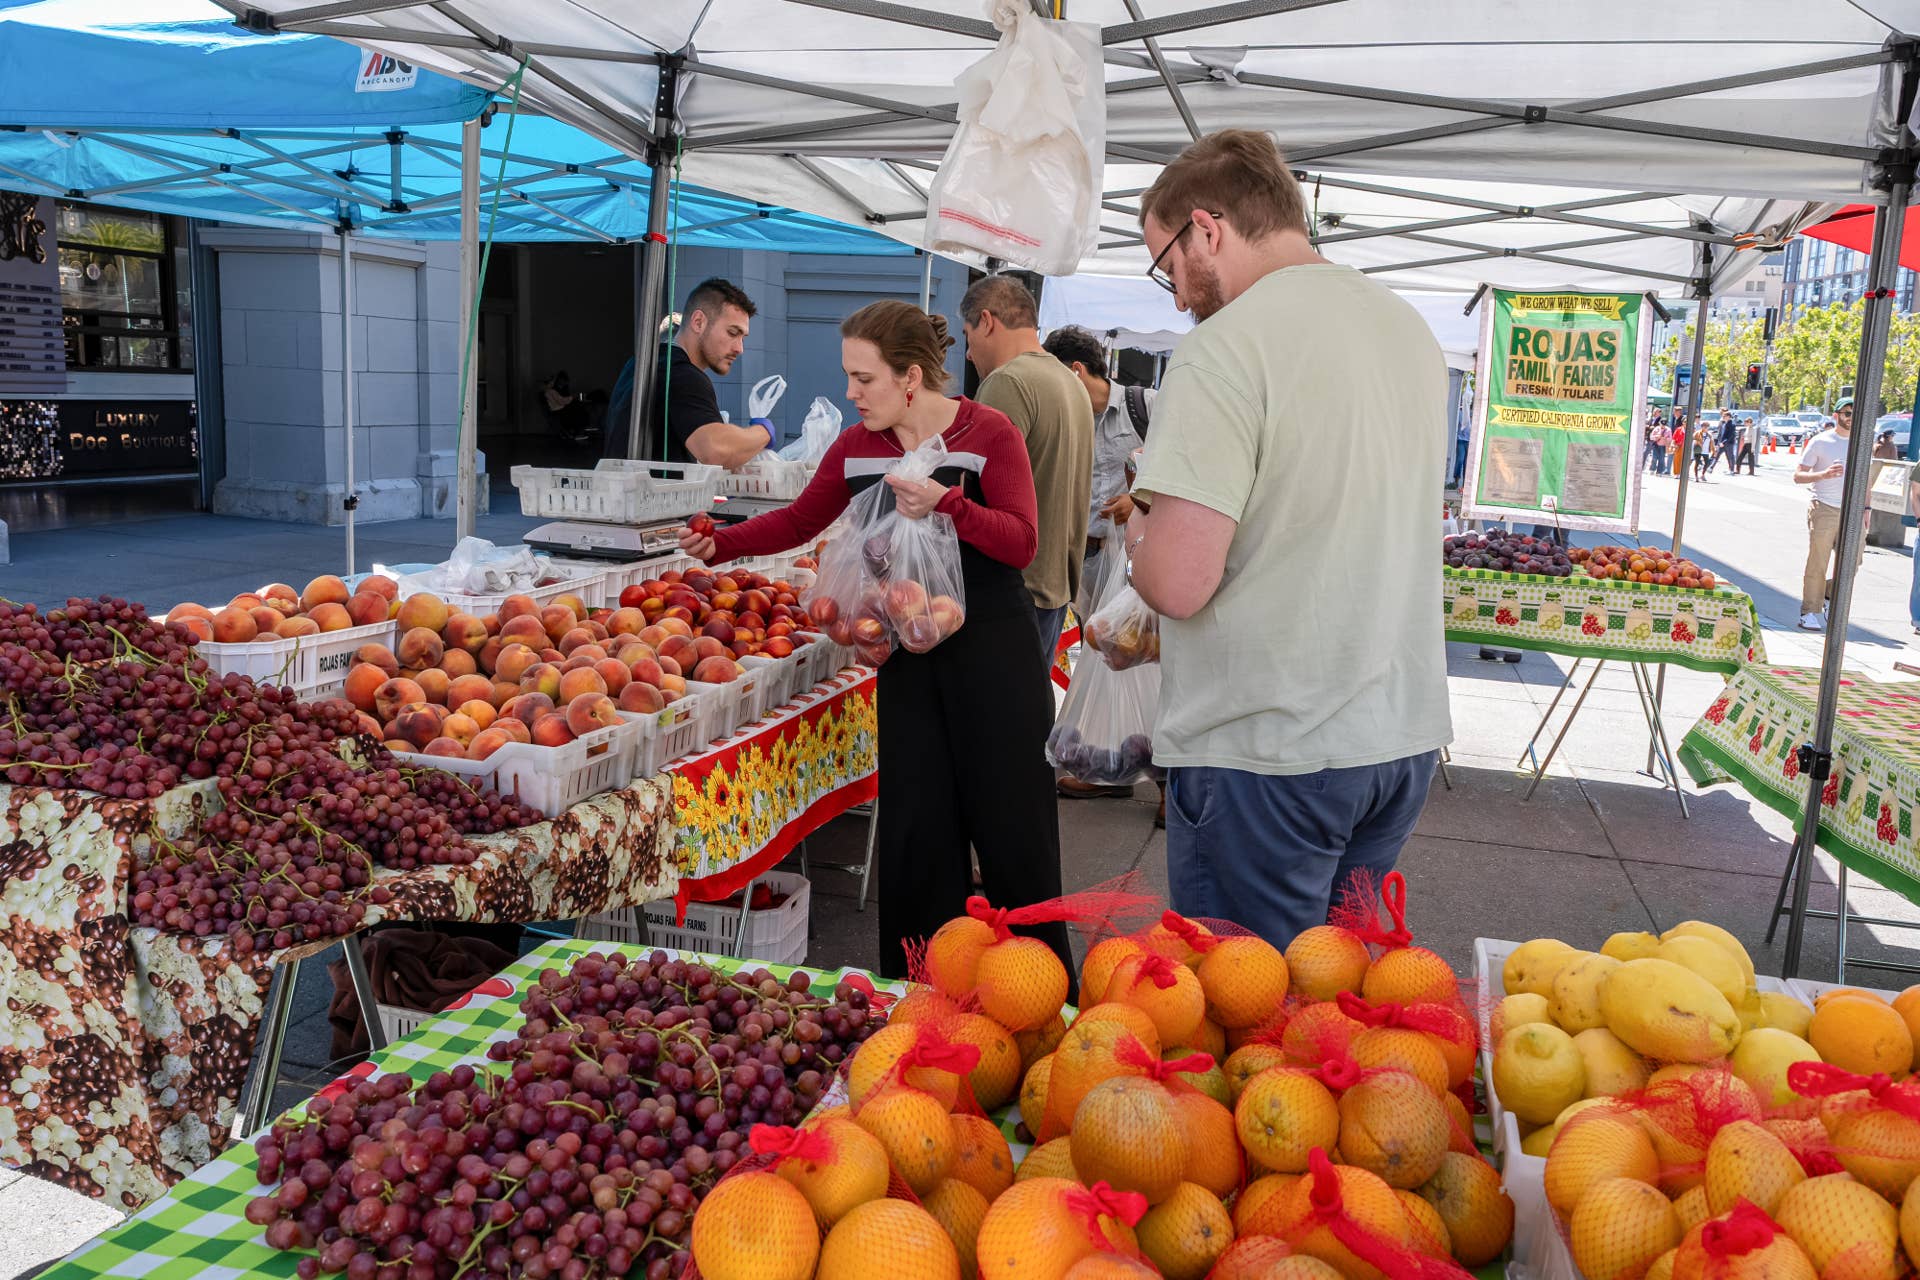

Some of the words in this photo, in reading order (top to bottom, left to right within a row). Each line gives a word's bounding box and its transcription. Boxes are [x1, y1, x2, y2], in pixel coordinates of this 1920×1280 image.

[1520, 296, 1532, 309] WE
[1533, 297, 1556, 309] GROW
[1557, 297, 1579, 310] WHAT
[1580, 298, 1592, 310] WE
[1593, 298, 1613, 311] SELL
[1509, 326, 1617, 363] ROJAS
[1508, 358, 1557, 385] FAMILY
[1562, 364, 1615, 387] FARMS
[1515, 383, 1555, 396] FRESNO
[1563, 387, 1605, 400] TULARE
[96, 410, 160, 427] LUXURY
[1501, 408, 1540, 424] CERTIFIED
[1541, 411, 1584, 428] CALIFORNIA
[1586, 415, 1617, 430] GROWN
[70, 432, 108, 450] DOG
[121, 433, 186, 449] BOUTIQUE
[320, 654, 339, 673] ROJAS
[340, 651, 354, 669] FAM
[687, 918, 707, 932] FARMS
